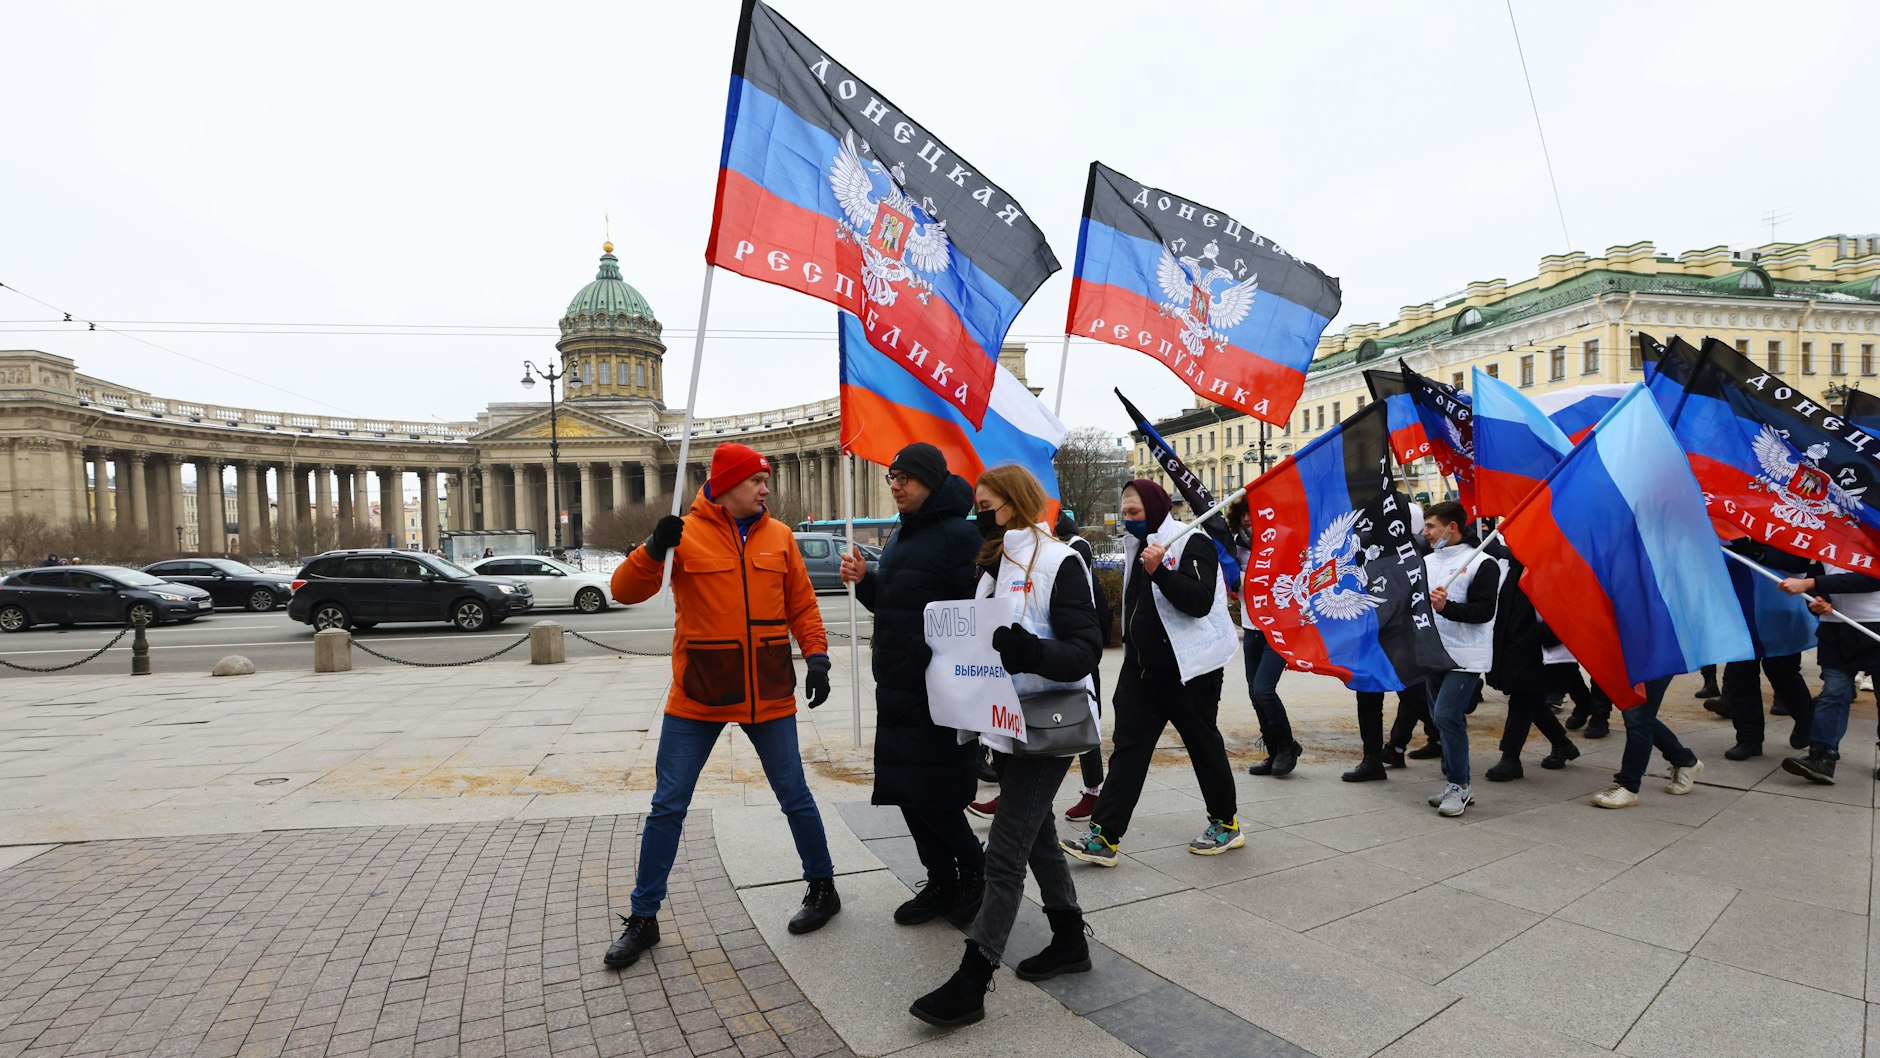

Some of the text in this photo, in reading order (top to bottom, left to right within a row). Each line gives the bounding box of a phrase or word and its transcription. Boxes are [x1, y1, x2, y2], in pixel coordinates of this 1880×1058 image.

[809, 56, 1022, 227] ДОНЕЦКАЯ
[1089, 318, 1270, 416] РЕСПУБЛИКА
[1702, 491, 1875, 569] ЕСПУБЛИ
[926, 606, 976, 638] МЫ
[955, 664, 1006, 679] ВЫБИРАЕМ
[992, 704, 1023, 738] Мир!
